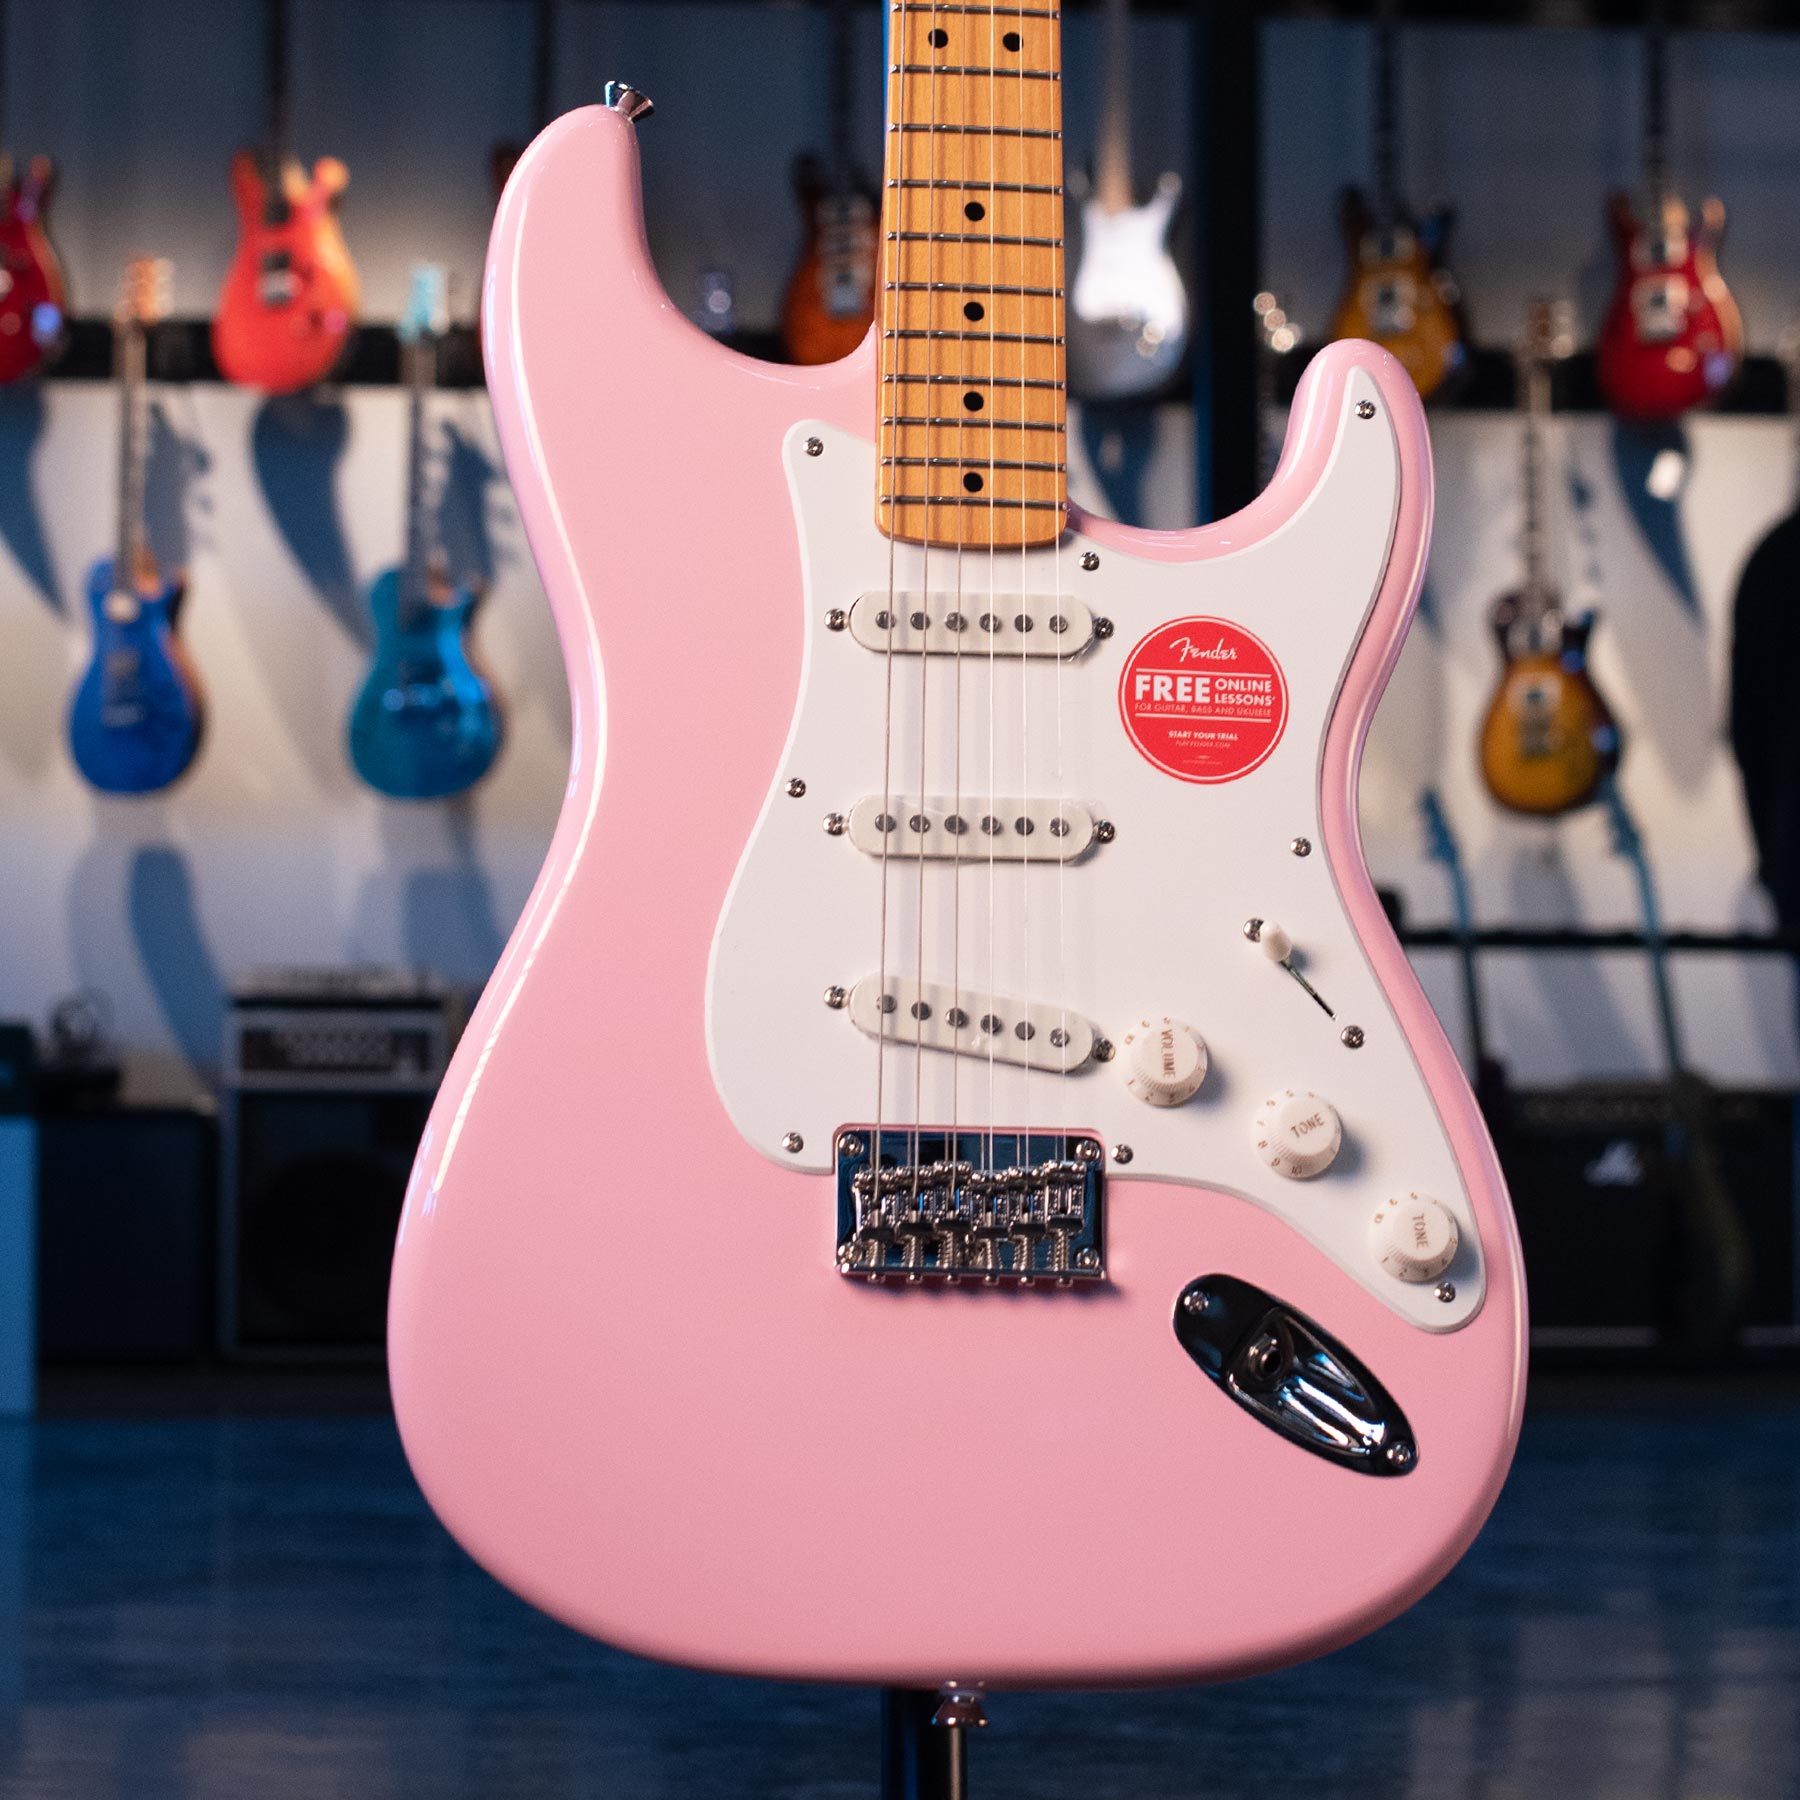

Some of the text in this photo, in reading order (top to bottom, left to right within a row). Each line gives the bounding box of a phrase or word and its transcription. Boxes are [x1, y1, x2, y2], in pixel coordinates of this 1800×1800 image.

[1169, 637, 1238, 662] Fender
[1135, 674, 1211, 704] FREE
[1214, 678, 1272, 693] ONLINE
[1135, 703, 1272, 716] FOR GUITAR, BASS AND UKULELE
[1168, 730, 1239, 741] START YOUR TRIAL
[1161, 1029, 1176, 1079] VOLUME
[1290, 1112, 1325, 1138] TONE
[1411, 1211, 1429, 1249] TONE
